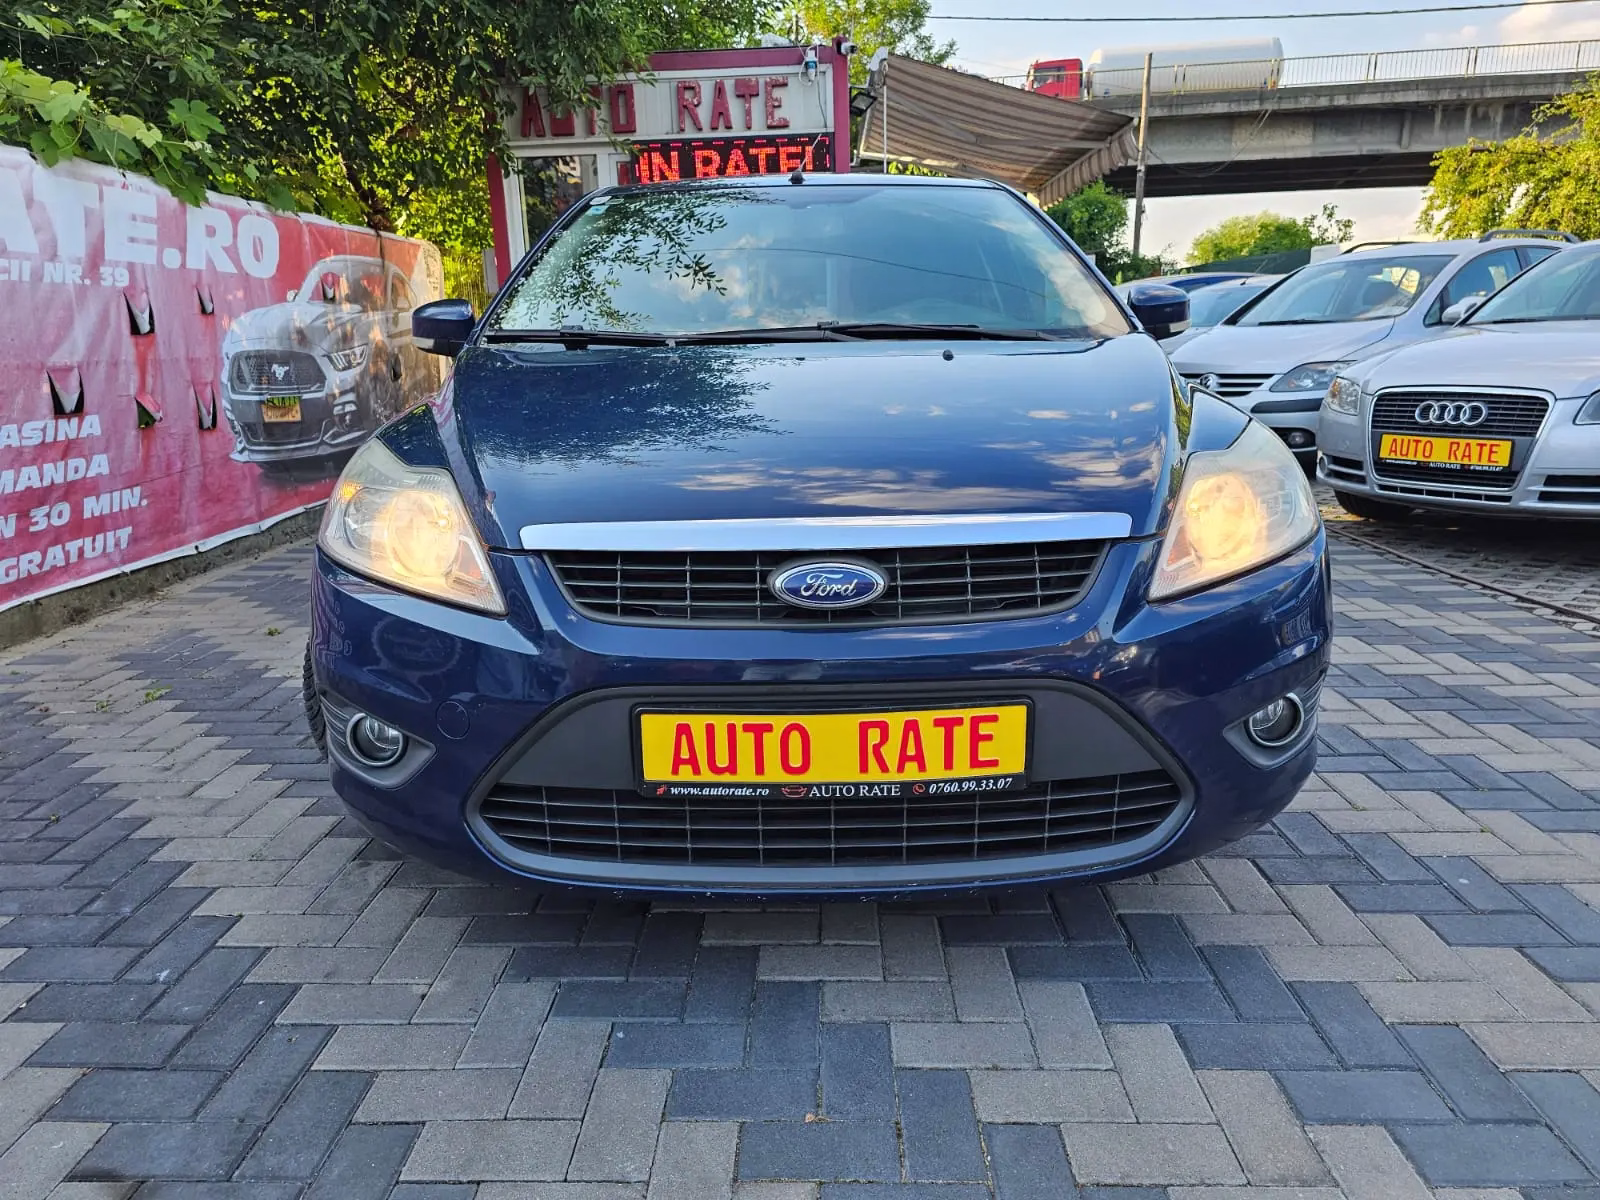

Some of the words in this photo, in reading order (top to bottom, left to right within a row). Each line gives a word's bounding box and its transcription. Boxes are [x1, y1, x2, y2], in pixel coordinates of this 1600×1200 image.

[677, 77, 790, 131] RATE
[639, 150, 681, 185] IN
[42, 262, 91, 285] NR.
[99, 266, 130, 287] 39
[0, 415, 101, 449] ASINA
[1388, 438, 1434, 459] AUTO
[1447, 441, 1501, 464] RATE
[29, 501, 71, 532] 30
[83, 486, 148, 519] MIN.
[0, 526, 132, 585] GRATUIT
[800, 573, 858, 598] Ford
[671, 723, 811, 776] AUTO
[858, 714, 1000, 774] RATE
[670, 786, 770, 797] www.autorate.ro
[808, 785, 855, 798] AUTO
[859, 784, 900, 797] RATE
[928, 778, 1013, 795] 0760.99.33.07
